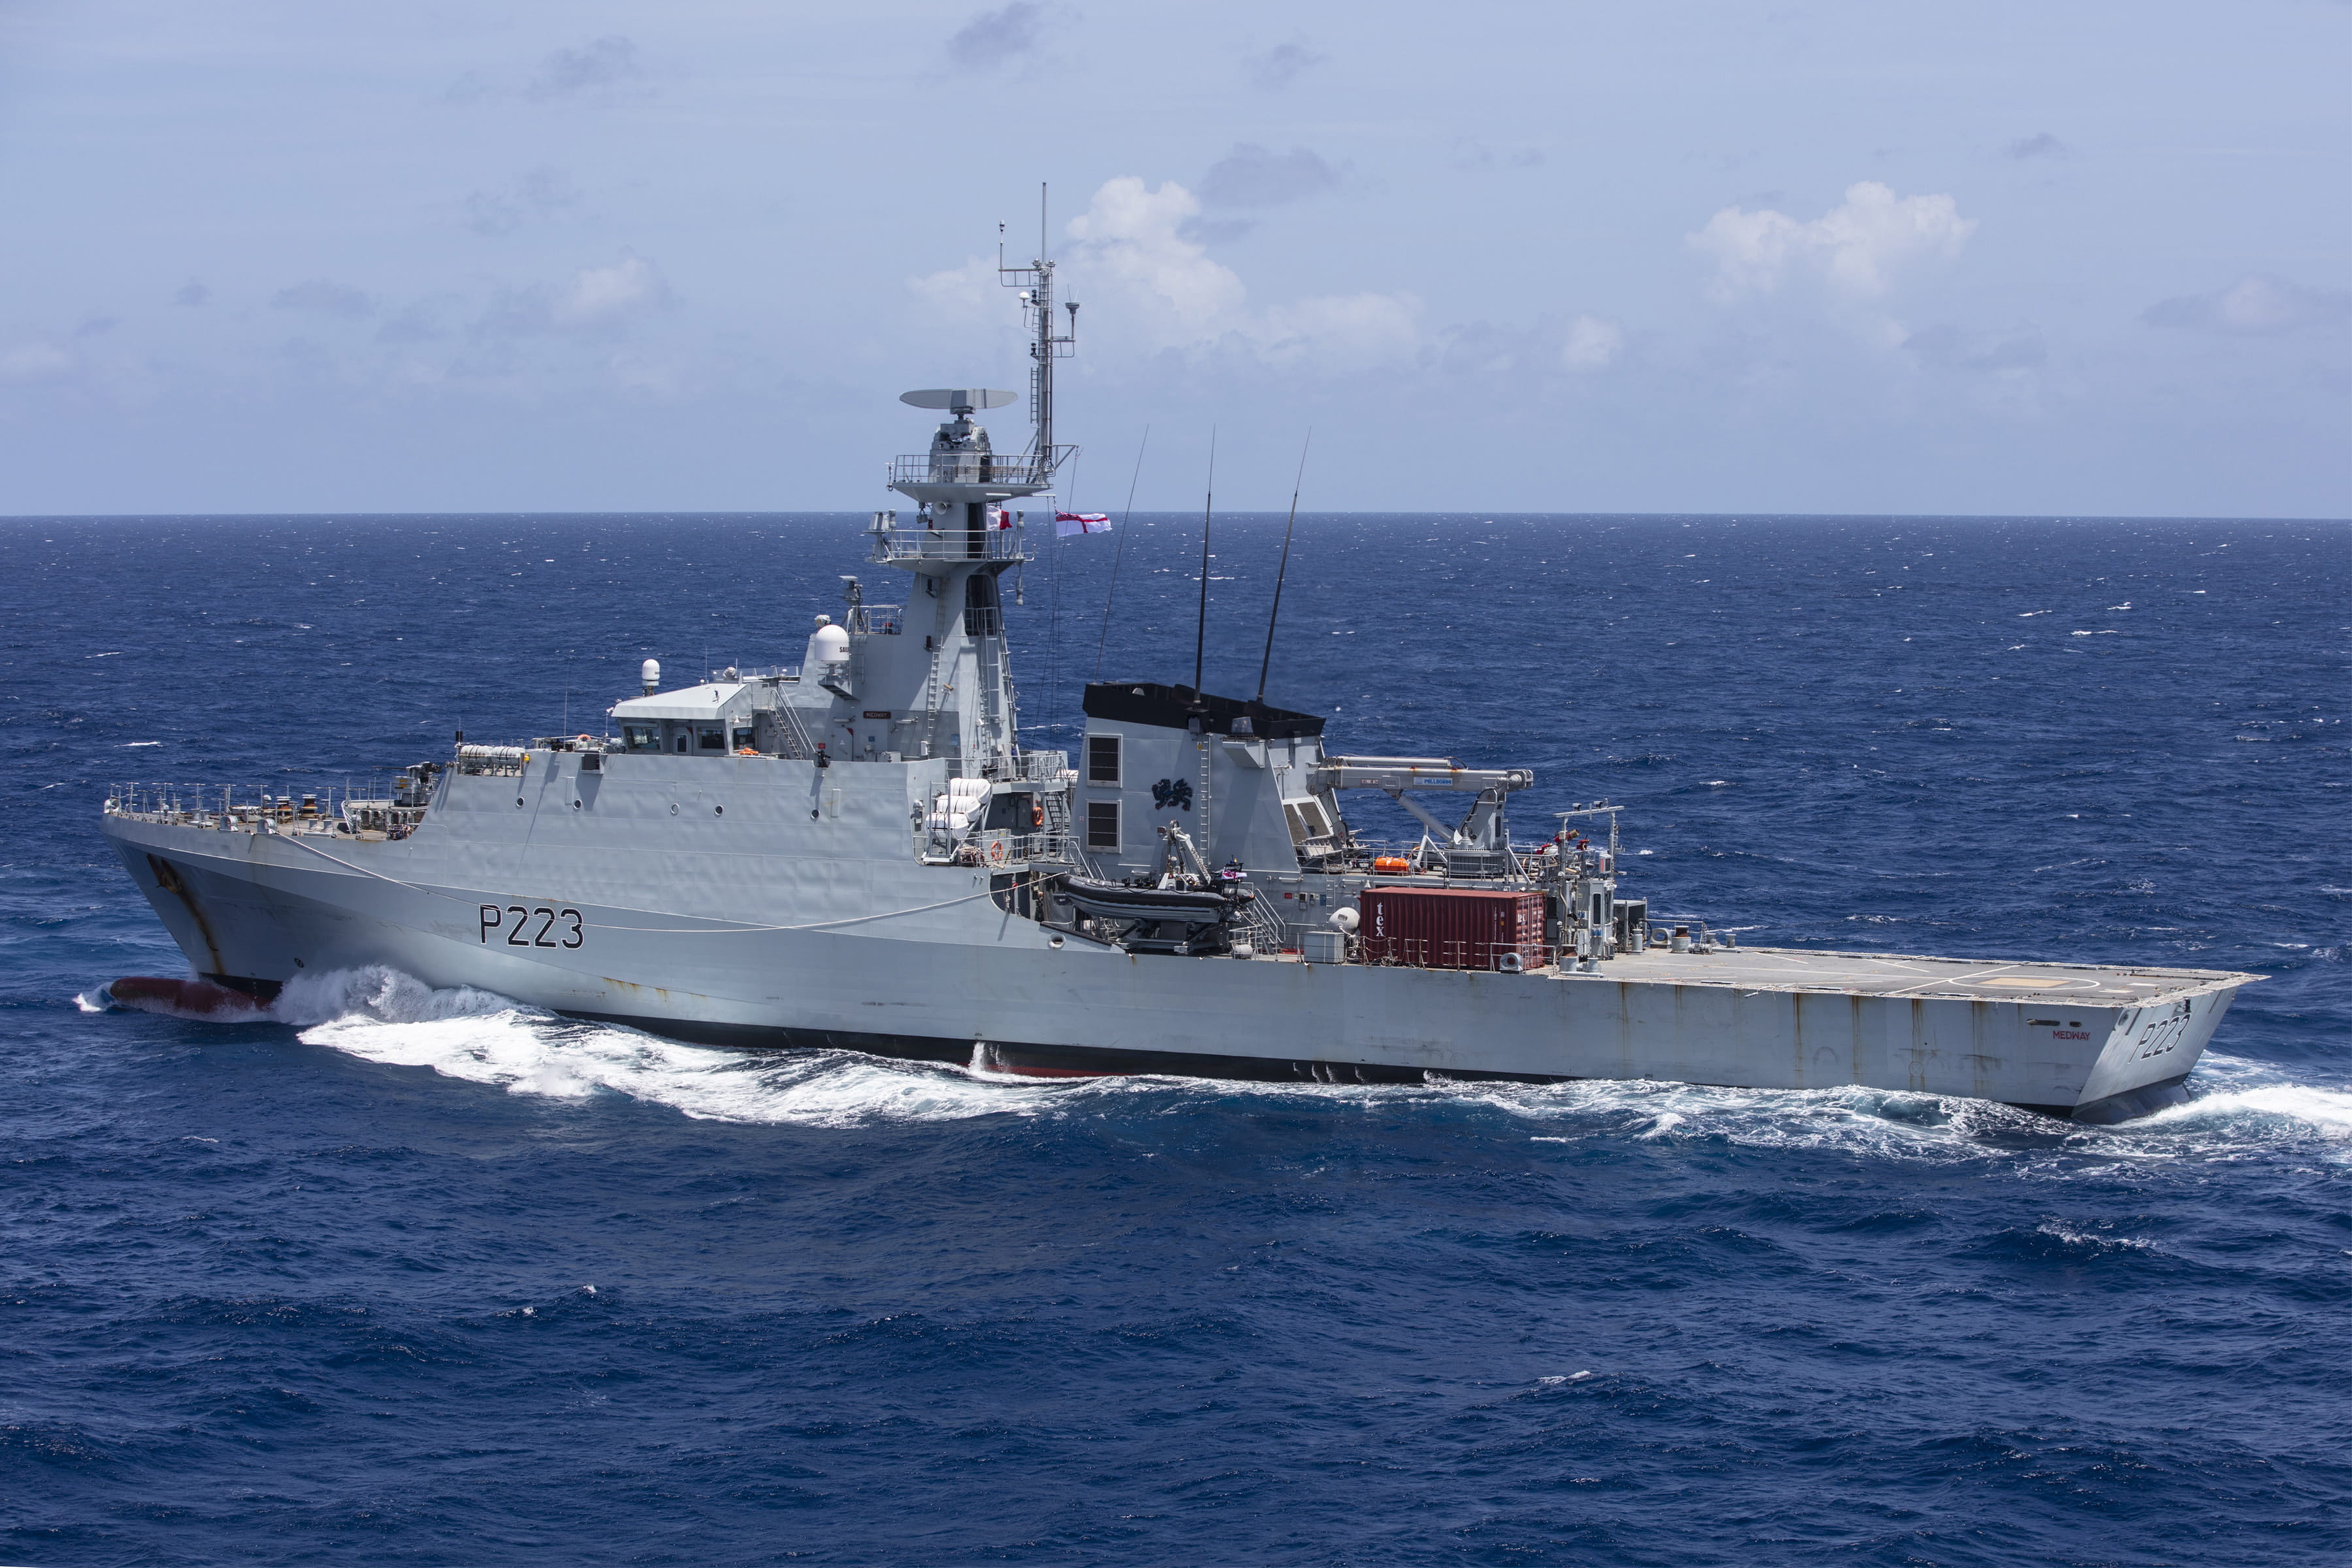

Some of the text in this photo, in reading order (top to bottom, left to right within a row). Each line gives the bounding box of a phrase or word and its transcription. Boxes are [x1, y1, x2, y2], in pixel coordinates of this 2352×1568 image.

[479, 904, 584, 950] P223
[1375, 902, 1384, 937] tex
[2053, 1030, 2090, 1041] MEDWAY
[2127, 1013, 2191, 1064] P223
